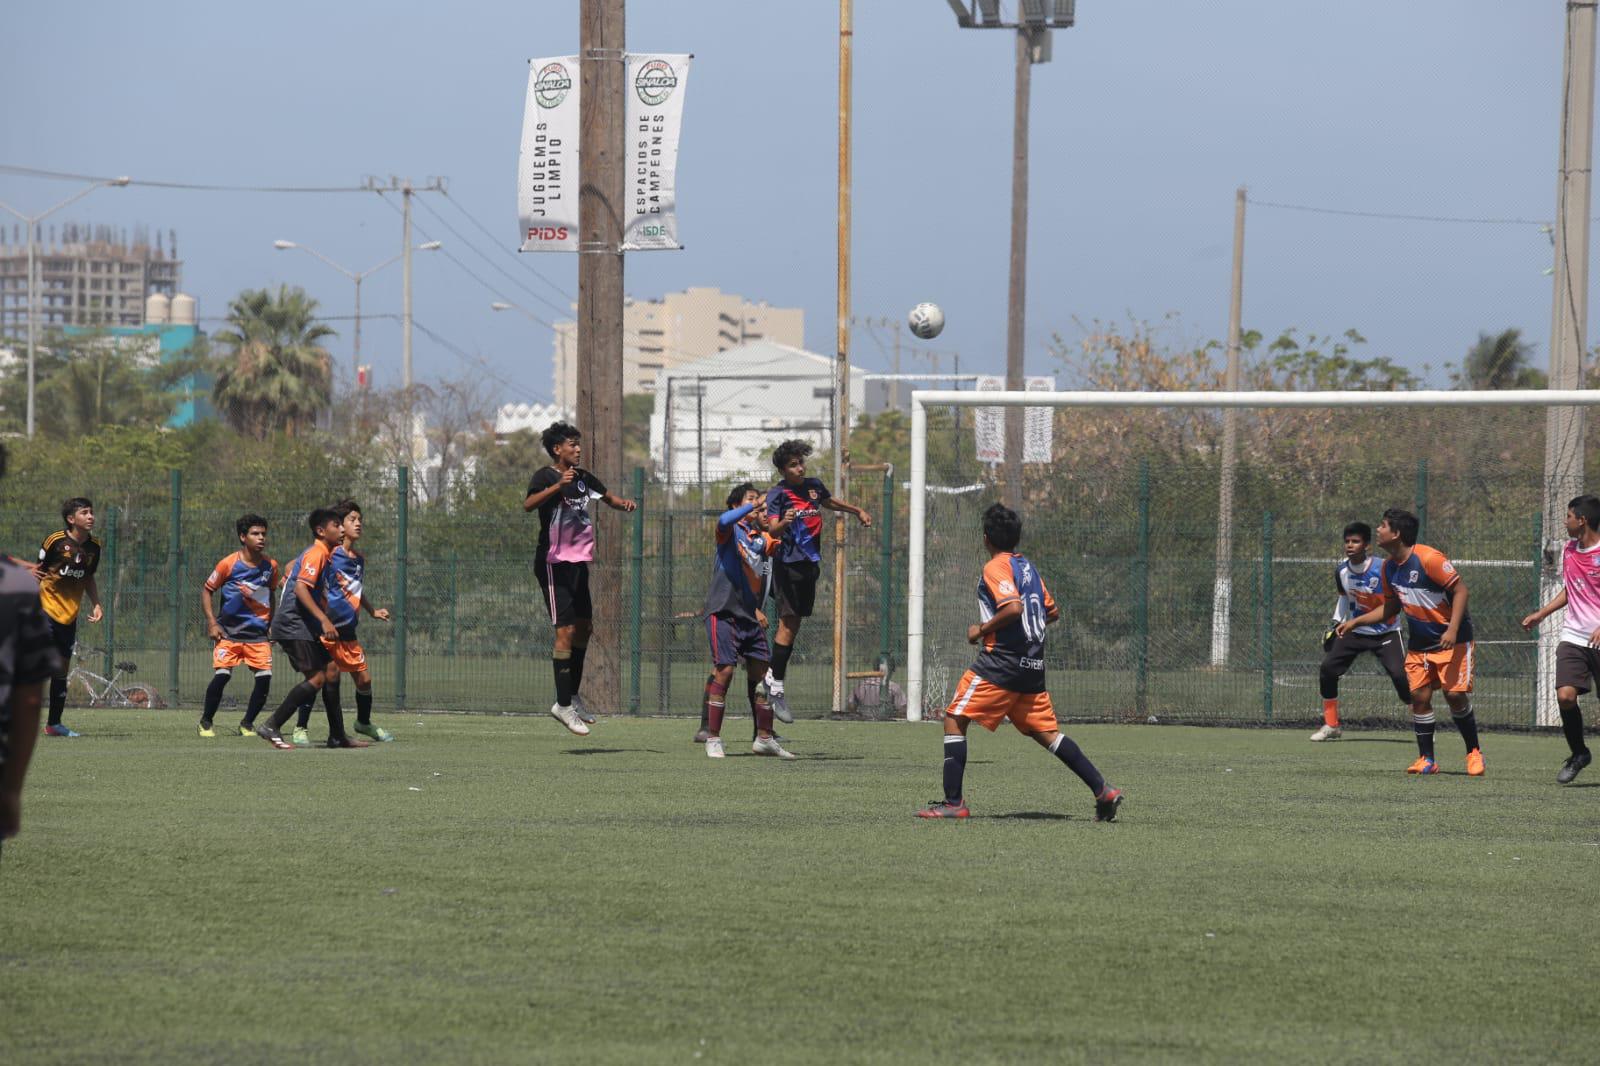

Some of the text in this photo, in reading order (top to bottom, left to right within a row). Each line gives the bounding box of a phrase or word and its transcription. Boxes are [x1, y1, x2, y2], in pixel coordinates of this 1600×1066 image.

[636, 77, 676, 88] SINALOA
[533, 122, 547, 216] JUGUEMOS
[549, 138, 562, 200] LIMPIO
[637, 115, 650, 215] ESPACIOS DE
[650, 114, 664, 214] CAMPEONES
[59, 565, 85, 579] Jeep
[1020, 592, 1046, 643] 10
